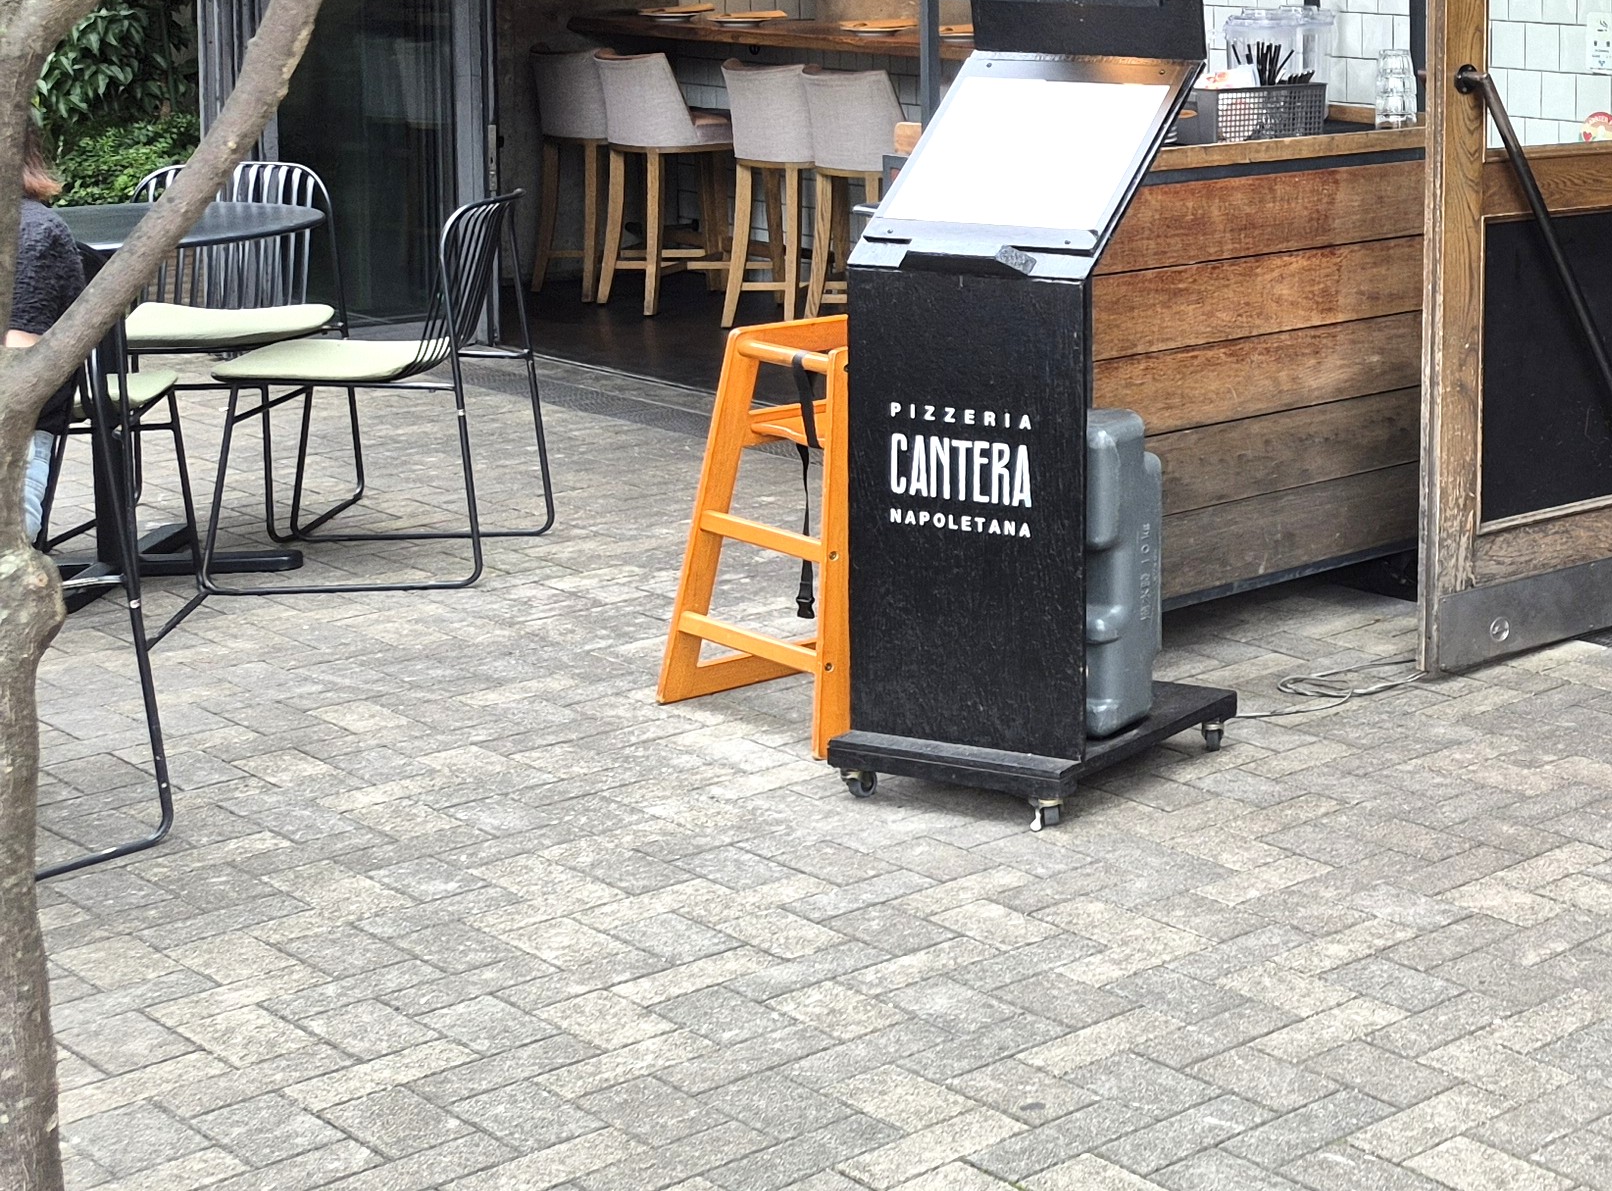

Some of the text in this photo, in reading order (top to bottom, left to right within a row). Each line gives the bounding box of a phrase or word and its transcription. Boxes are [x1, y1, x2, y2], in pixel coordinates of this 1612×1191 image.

[889, 401, 1032, 431] PIZZERIA
[889, 432, 1033, 508] CANTERA
[889, 507, 1032, 539] NAPOLETANA
